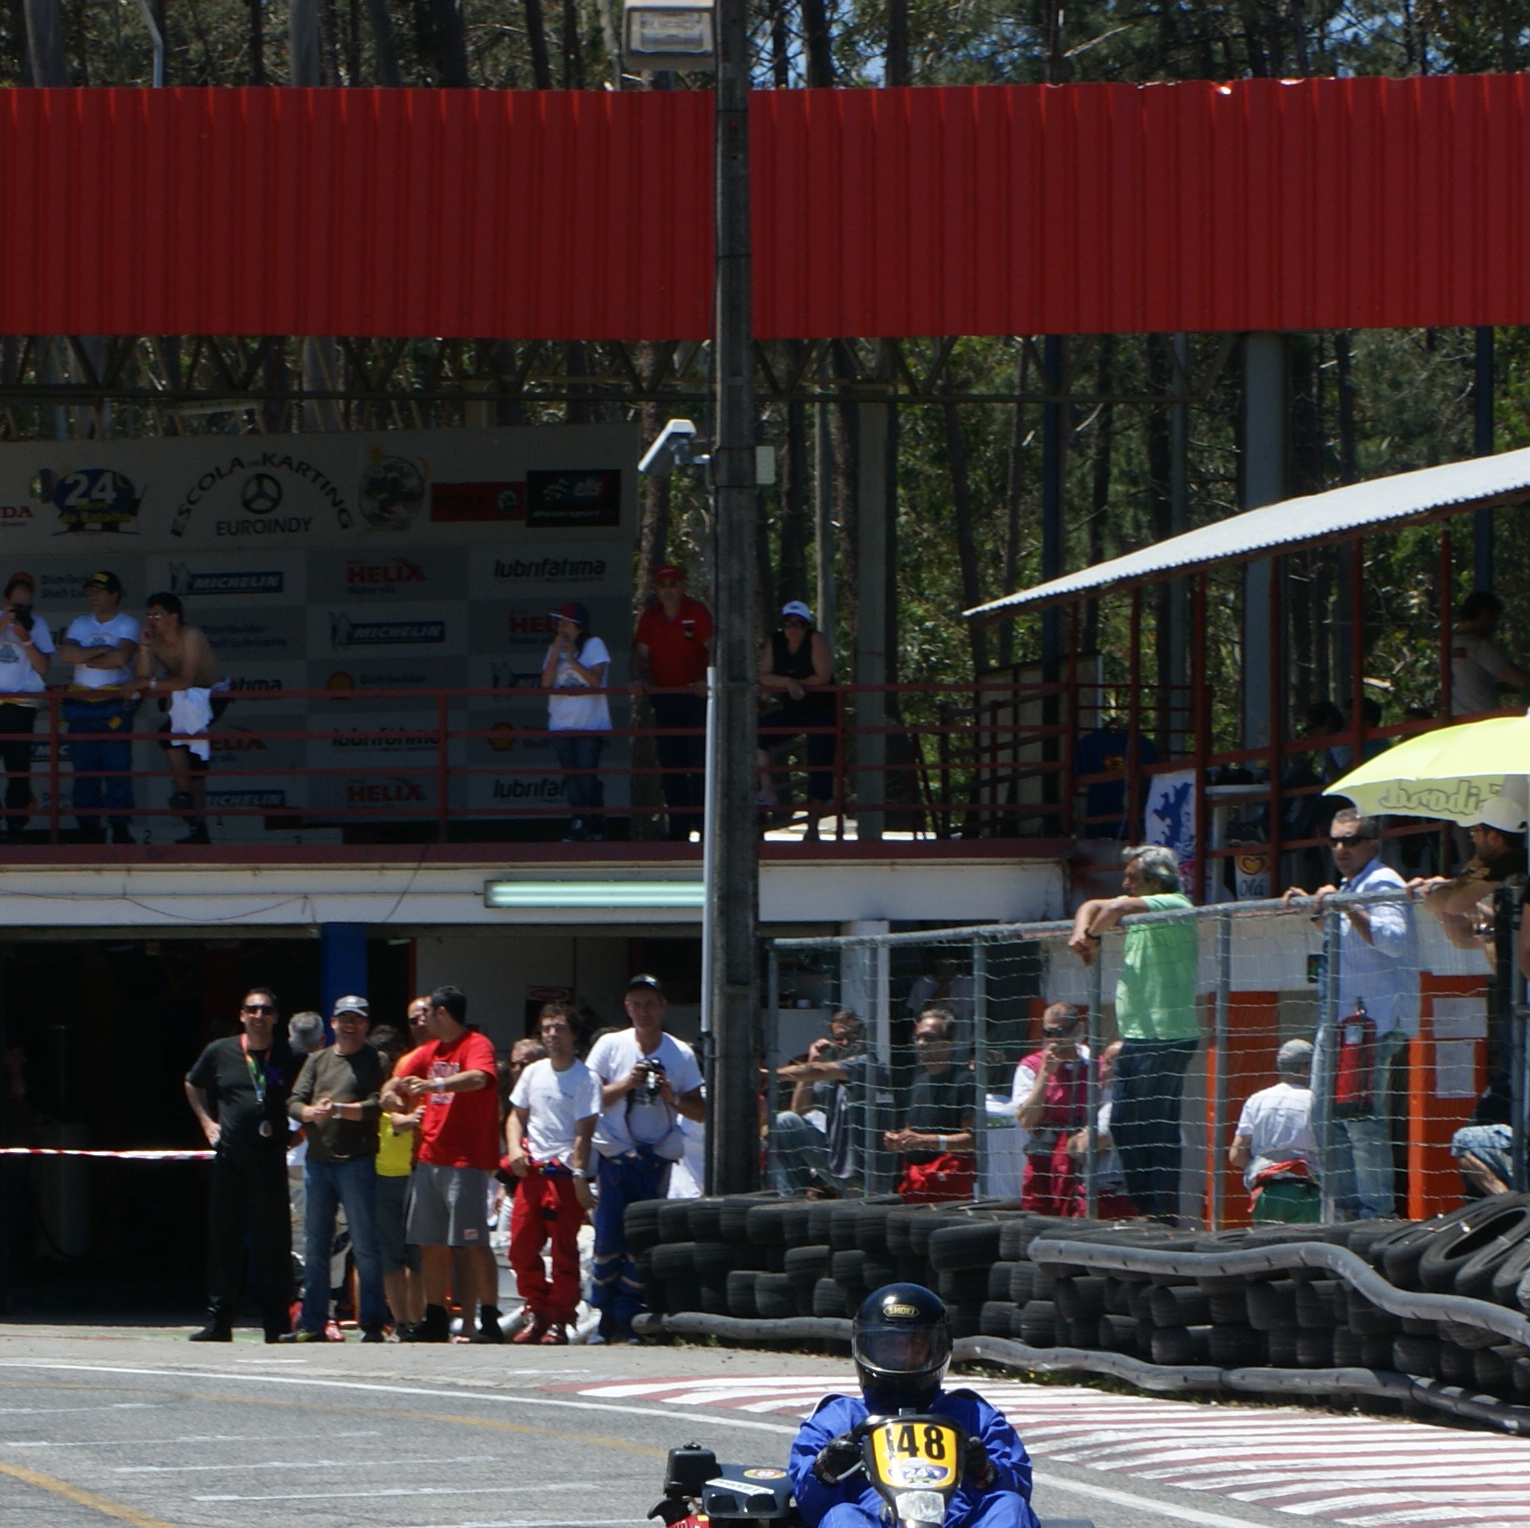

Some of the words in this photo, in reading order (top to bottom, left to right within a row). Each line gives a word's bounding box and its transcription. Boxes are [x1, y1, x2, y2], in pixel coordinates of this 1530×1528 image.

[63, 471, 117, 506] 24
[171, 457, 245, 537] ESCOLA
[262, 453, 353, 529] KARTING
[215, 517, 313, 536] EUROINDY
[347, 563, 427, 583] HELIX
[509, 616, 557, 634] HEL
[346, 782, 427, 802] HELIX
[1240, 877, 1263, 897] Olá
